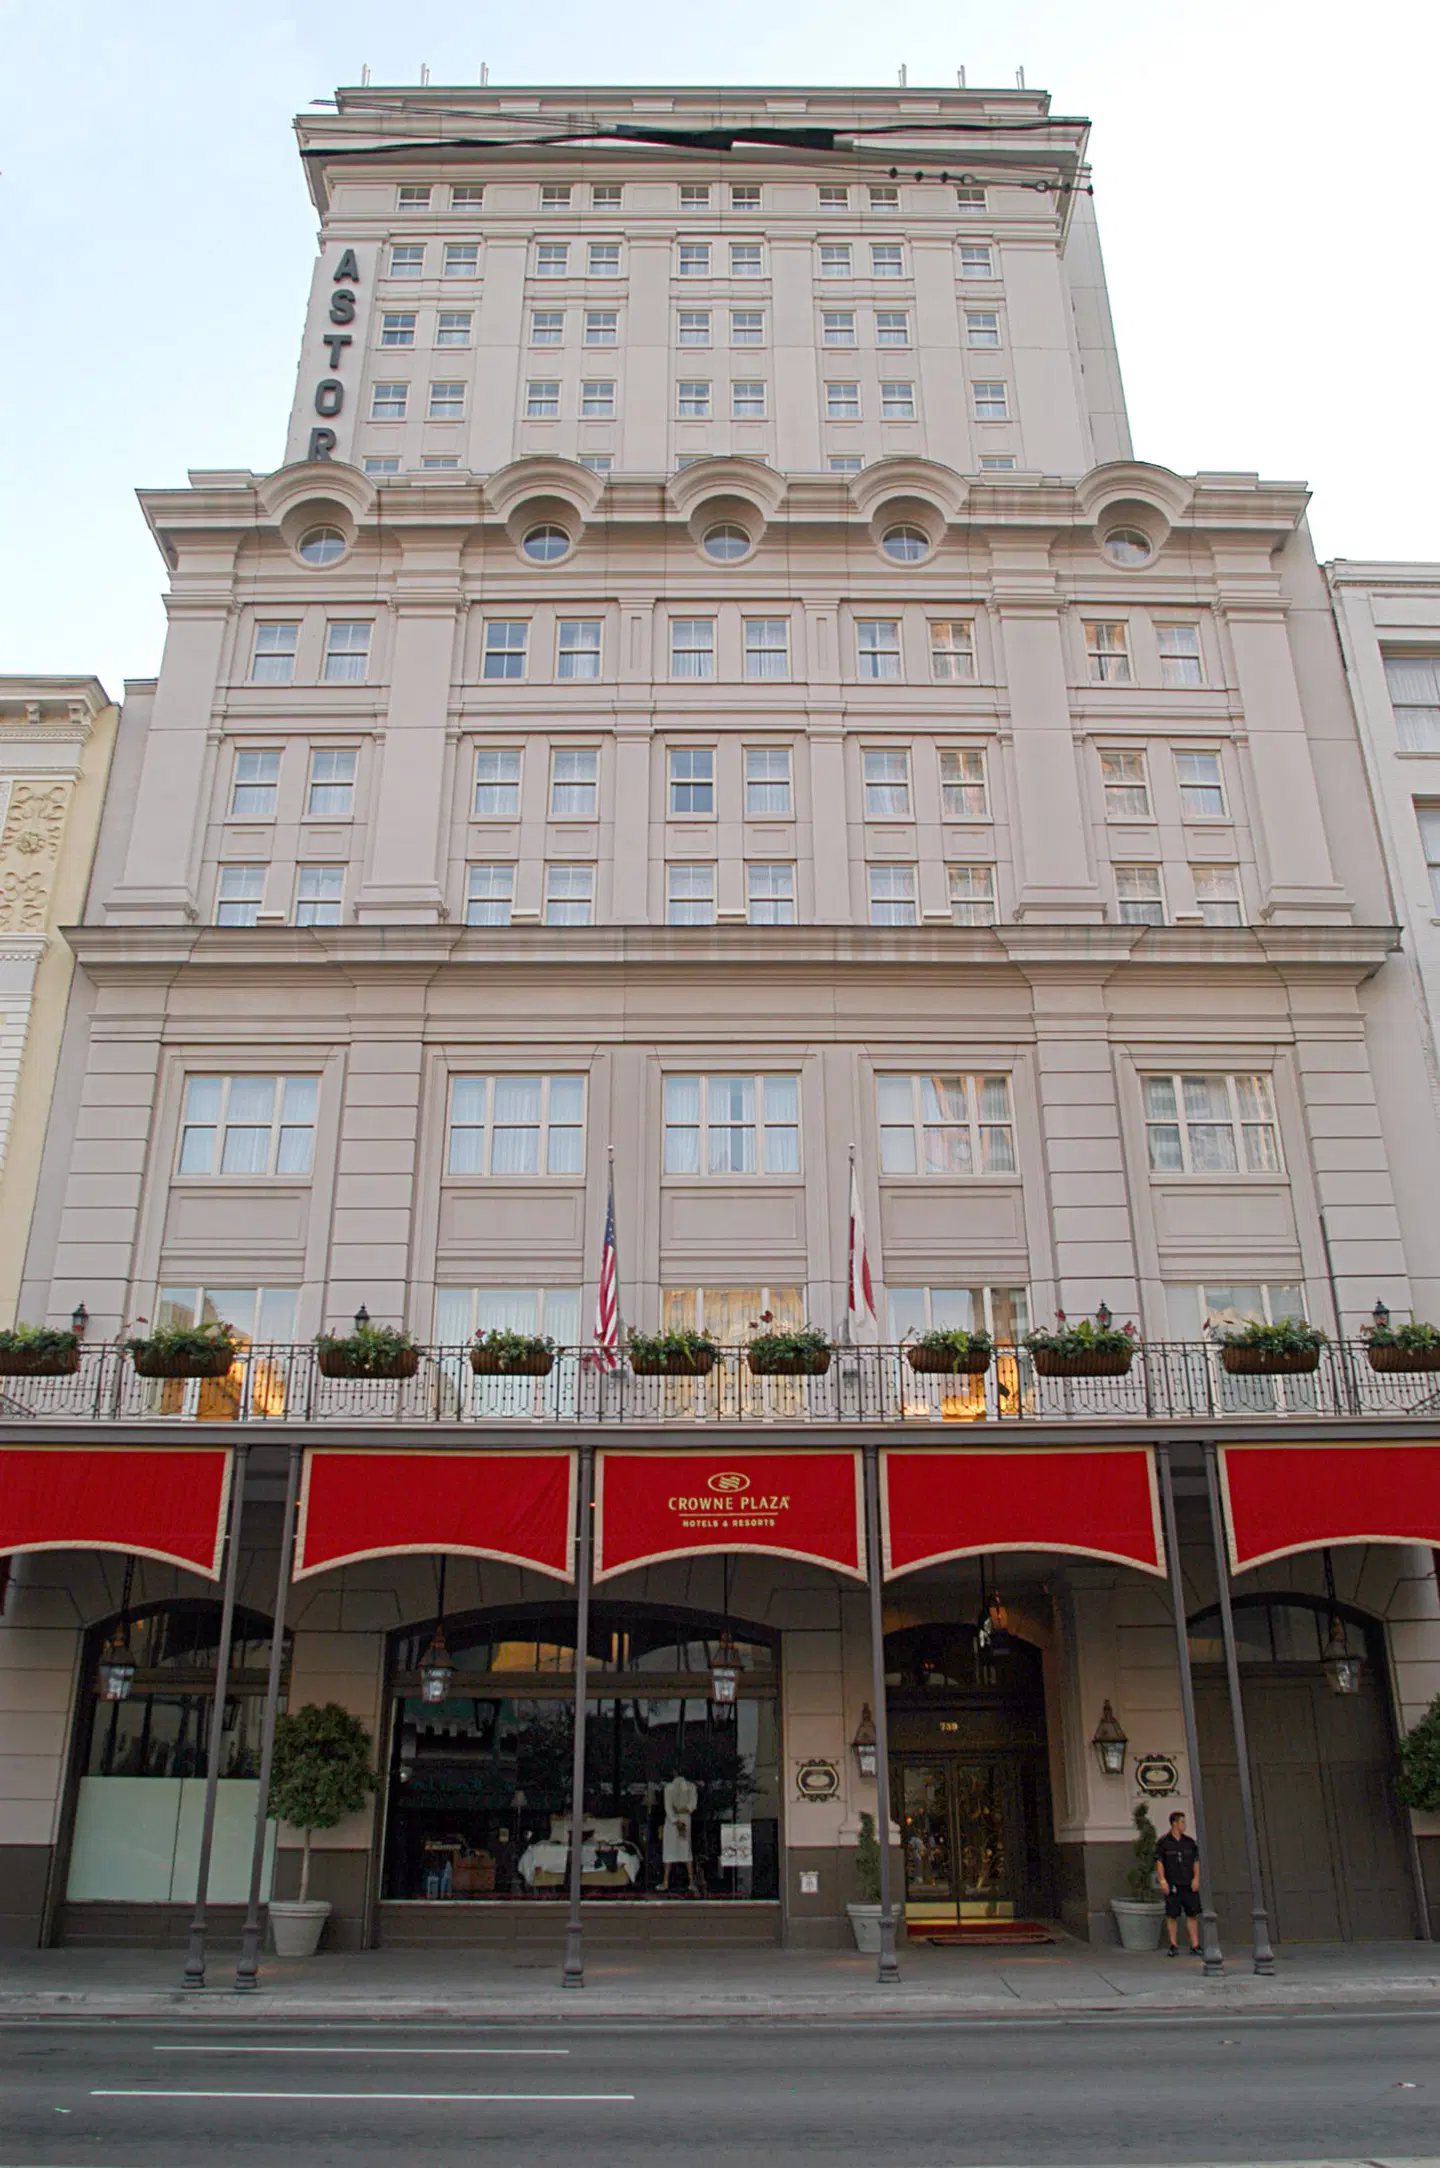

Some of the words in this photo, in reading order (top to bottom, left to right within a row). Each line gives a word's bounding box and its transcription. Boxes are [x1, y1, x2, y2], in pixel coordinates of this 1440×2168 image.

[307, 249, 359, 460] ASTOR
[668, 1497, 733, 1510] CROWNE
[740, 1496, 789, 1510] PLAZA
[682, 1519, 719, 1528] HOTELS
[732, 1518, 775, 1527] RESORTS
